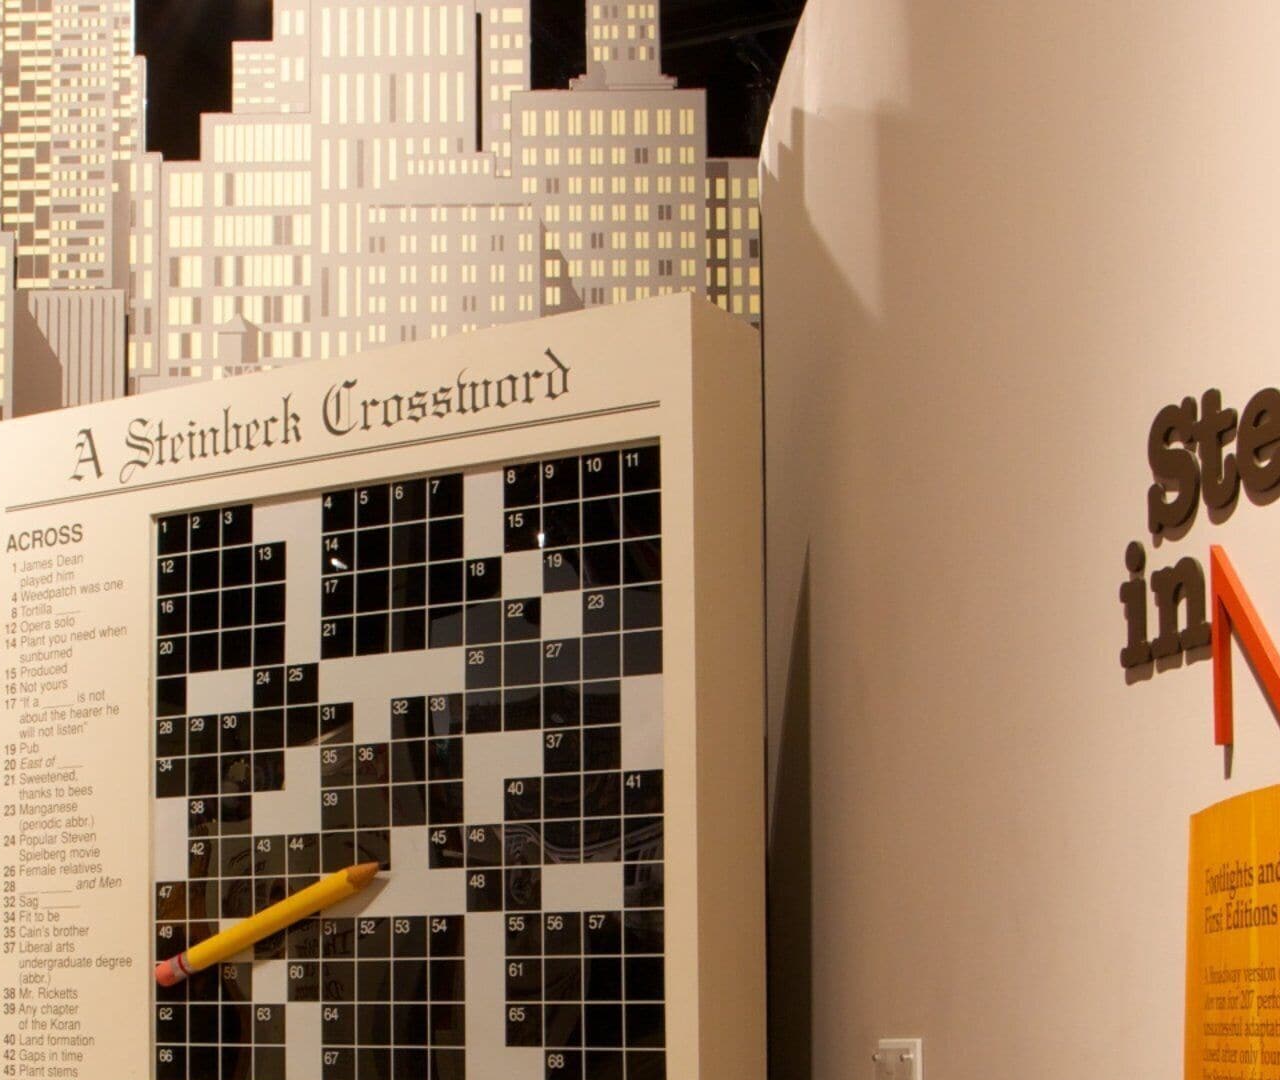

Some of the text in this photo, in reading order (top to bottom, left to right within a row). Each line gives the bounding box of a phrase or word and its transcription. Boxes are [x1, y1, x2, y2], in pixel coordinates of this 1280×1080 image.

[69, 348, 570, 482] A Steinbeck Crossword
[587, 458, 601, 472] 10
[627, 453, 638, 466] 11
[507, 470, 515, 484] 8
[545, 465, 554, 478] 9
[395, 486, 403, 499] 6
[432, 480, 439, 493] 7
[324, 497, 332, 510] 4
[360, 491, 368, 504] 5
[192, 516, 200, 529] 2
[225, 511, 232, 524] 3
[161, 522, 166, 532] 1
[6, 524, 83, 552] ACROSS
[1120, 541, 1211, 668] in
[1225, 900, 1278, 930] Editions
